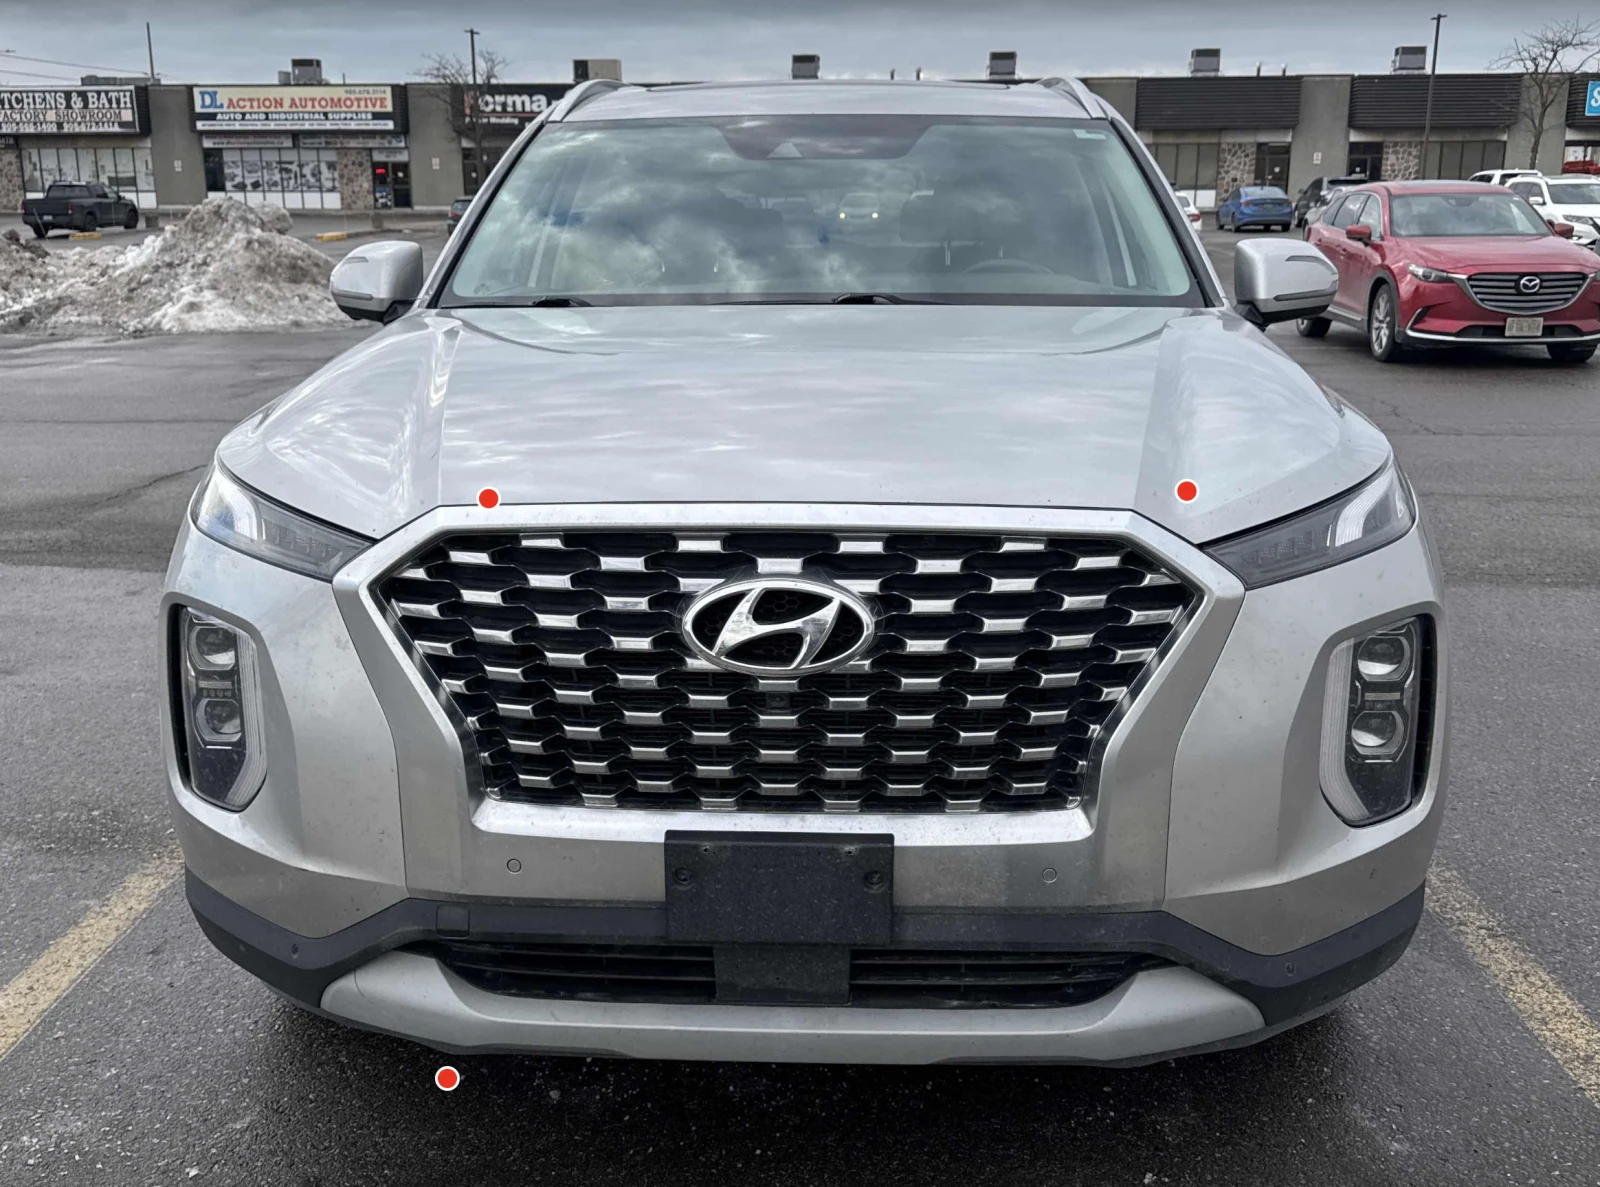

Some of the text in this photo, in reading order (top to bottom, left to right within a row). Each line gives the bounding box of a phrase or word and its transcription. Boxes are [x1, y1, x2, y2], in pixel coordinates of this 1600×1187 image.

[0, 92, 132, 109] TCHENS & BATH
[199, 90, 387, 109] DL ACTION AUTOMOTIVE
[55, 110, 121, 121] SHOWROOM
[269, 112, 325, 120] INDUSTRIAL
